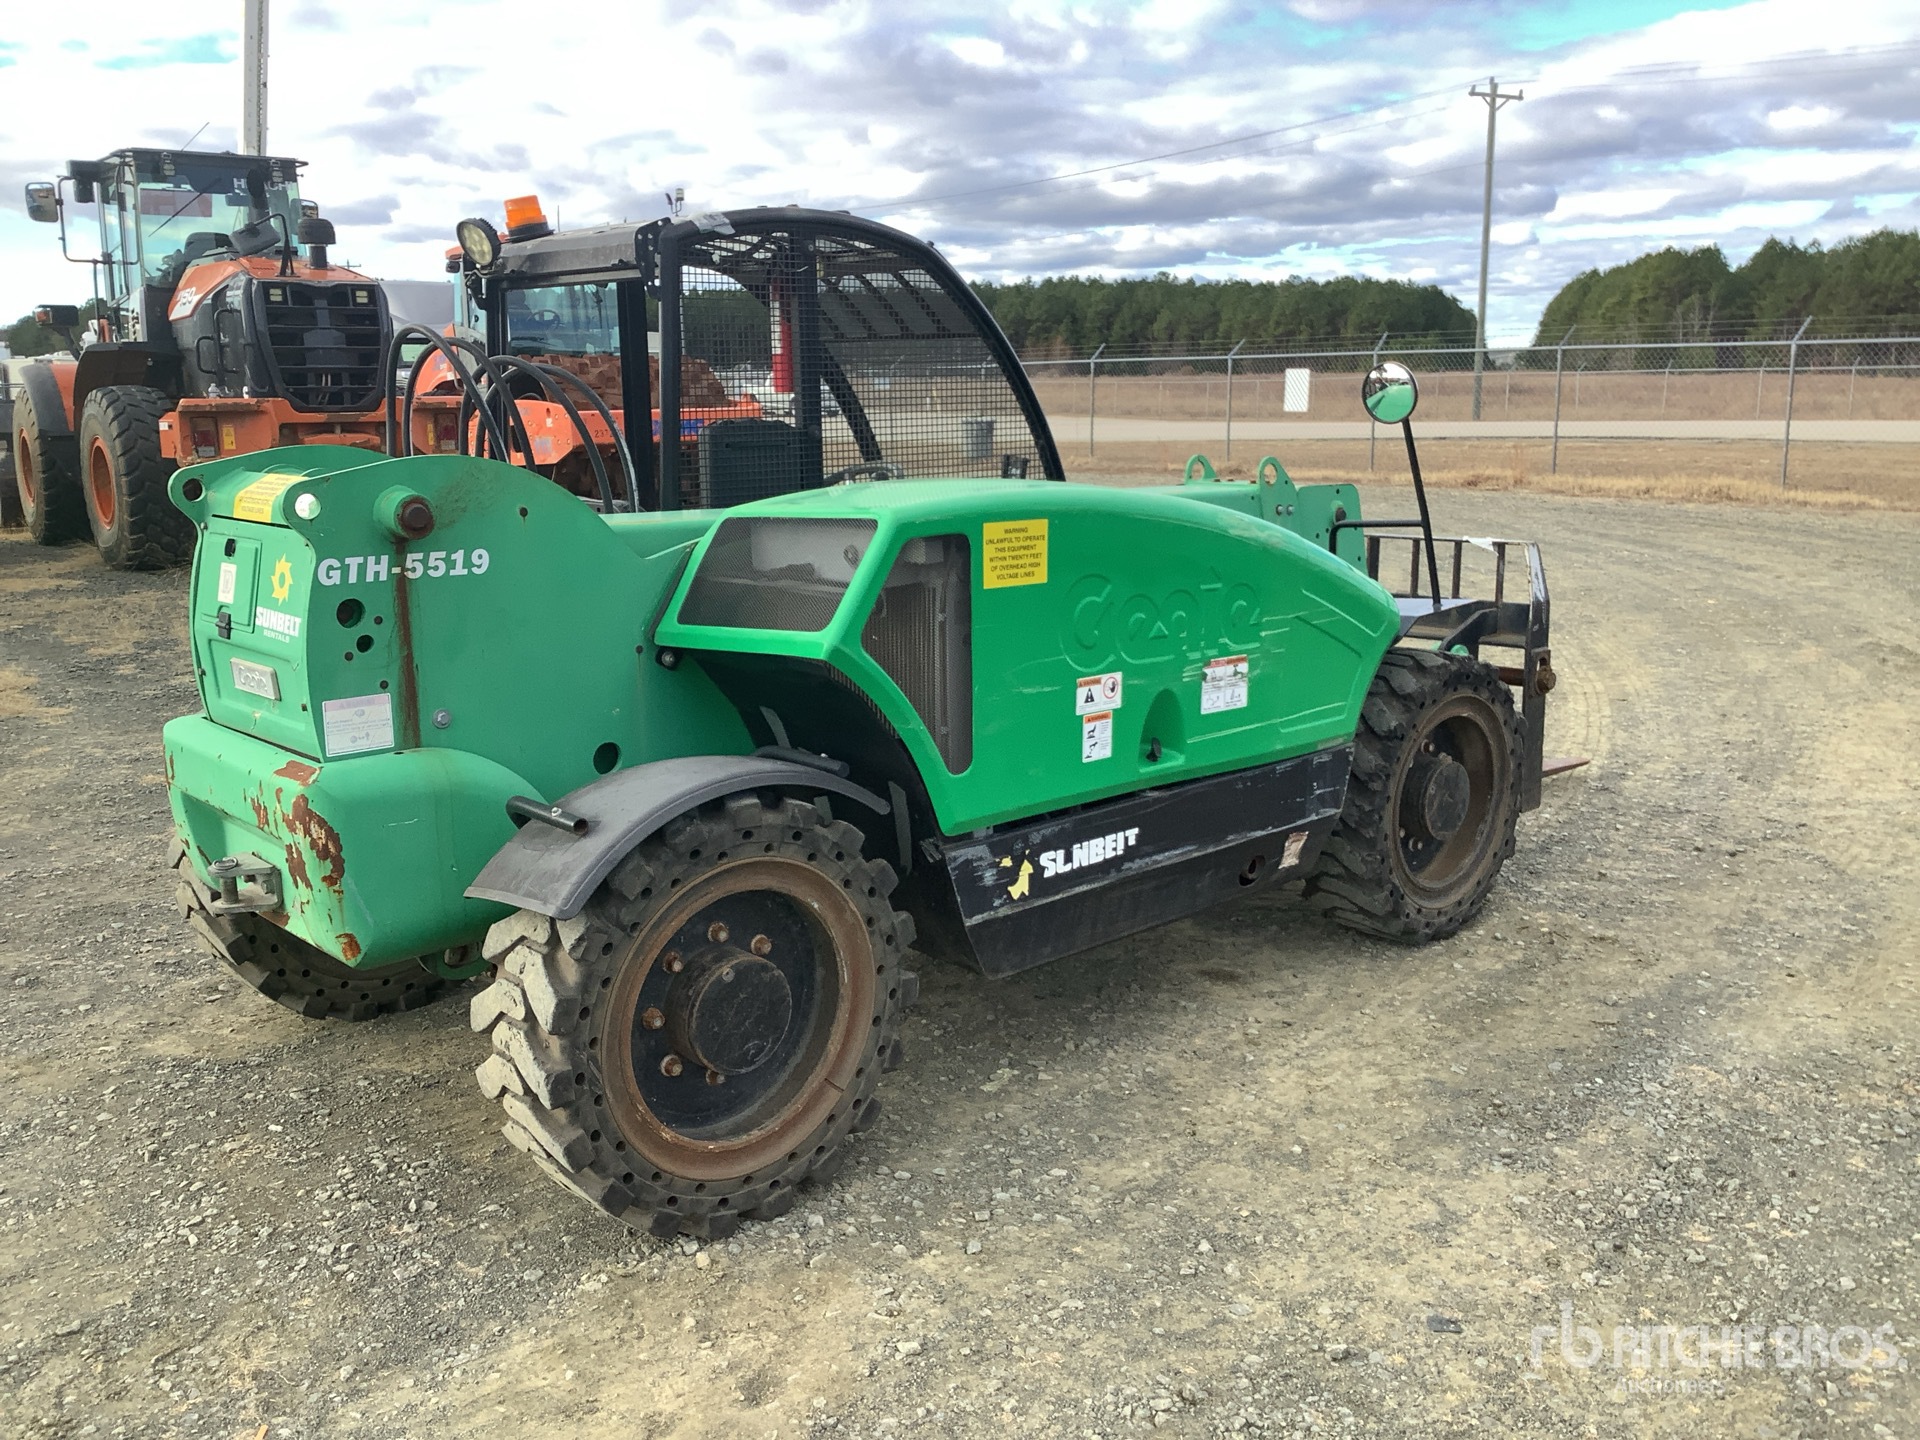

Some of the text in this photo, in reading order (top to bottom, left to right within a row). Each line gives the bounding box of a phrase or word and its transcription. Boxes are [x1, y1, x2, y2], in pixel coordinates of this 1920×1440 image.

[986, 537, 1014, 545] UNLAWFUL
[1022, 534, 1046, 542] OPERATE
[1007, 544, 1037, 553] EQUIPMENT
[989, 555, 1007, 563] WITHIN
[317, 548, 490, 586] GTH-5519
[990, 564, 998, 572] OF
[999, 563, 1027, 571] OVERHEAD
[996, 572, 1019, 580] VOLTAGE
[255, 606, 302, 637] SUNBELT
[263, 628, 290, 643] RENTALS
